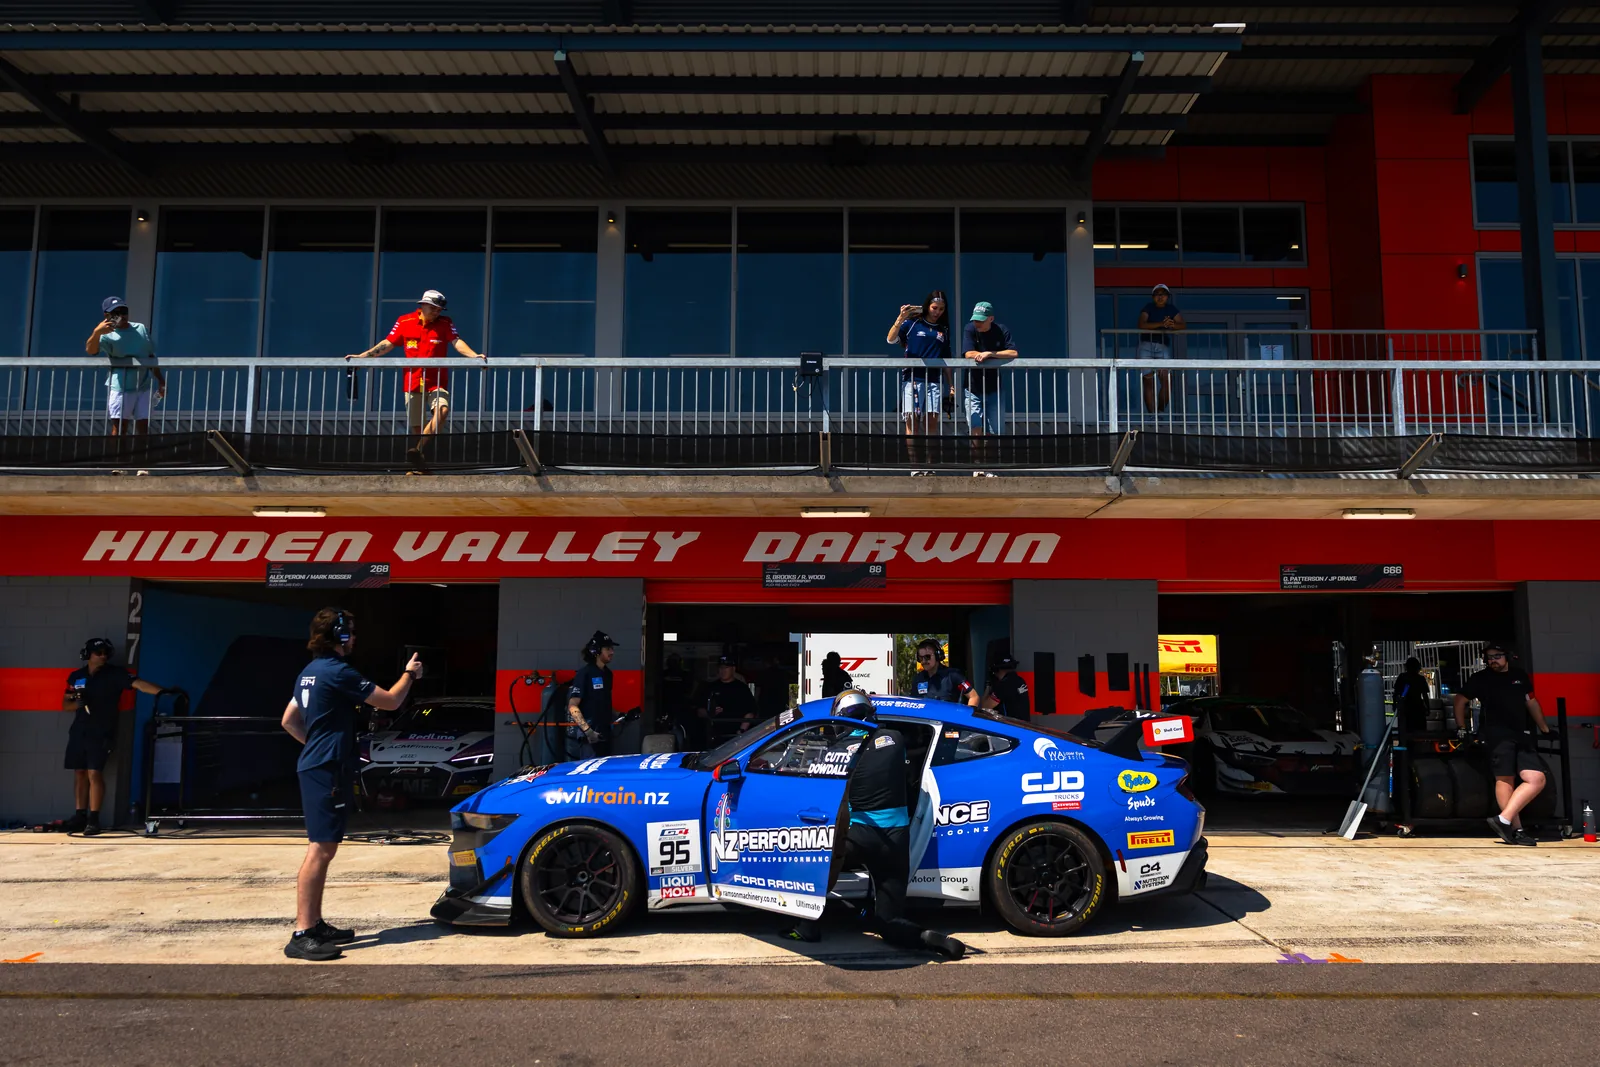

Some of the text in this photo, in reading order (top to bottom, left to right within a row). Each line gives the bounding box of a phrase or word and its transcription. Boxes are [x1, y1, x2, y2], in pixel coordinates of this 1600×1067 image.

[82, 530, 1061, 563] HIDDEN VALLEY DARWIN
[370, 564, 388, 573] 268
[1383, 566, 1402, 574] 666
[825, 752, 852, 763] CUTTS
[808, 763, 848, 775] DOWDALL
[1022, 771, 1084, 792] CJD
[546, 785, 670, 804] civiltrain.nz
[1127, 795, 1155, 810] Spuds
[1131, 832, 1170, 845] PIRELLI
[529, 826, 566, 865] PIRELLI
[1000, 833, 1023, 868] ZERO
[660, 840, 690, 866] 95
[1140, 862, 1161, 874] C4
[662, 876, 693, 887] LIQUI
[734, 874, 815, 892] FORD RACING
[940, 876, 968, 884] Group
[1142, 881, 1166, 889] SYSTEMS
[1143, 875, 1169, 884] NUTRITION
[662, 887, 694, 898] MOLY
[723, 890, 777, 903] ramsonmachinery.co.nz
[1082, 874, 1102, 920] PIRELLI
[796, 899, 820, 911] Ultimate
